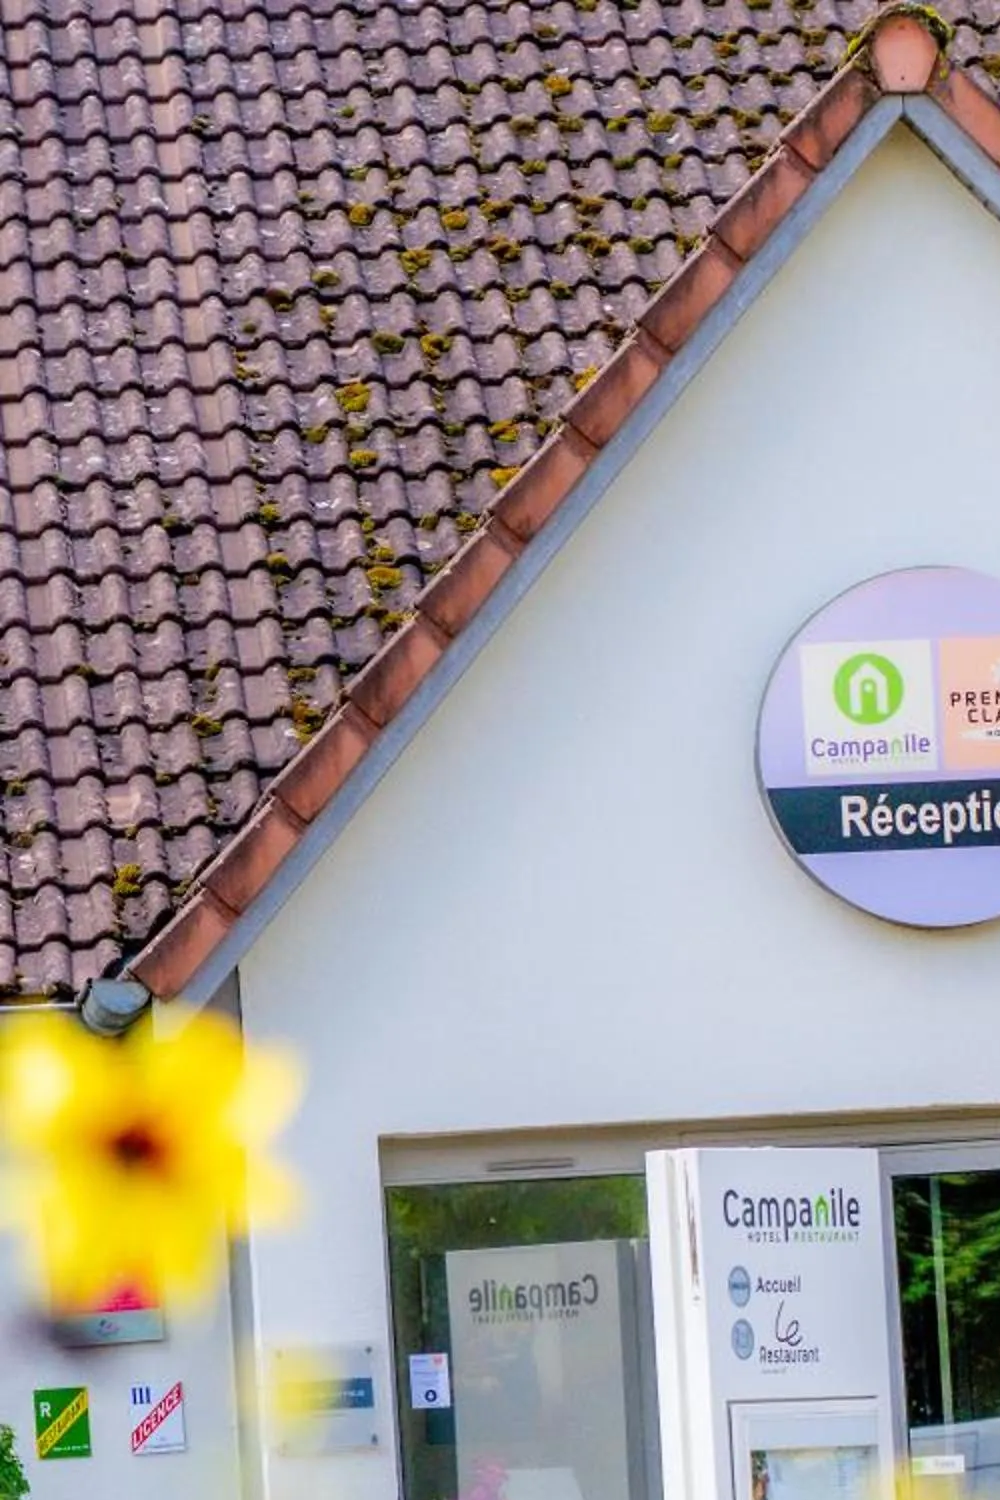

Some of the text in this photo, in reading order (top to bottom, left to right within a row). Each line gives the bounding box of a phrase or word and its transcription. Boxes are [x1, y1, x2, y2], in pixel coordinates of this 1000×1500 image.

[811, 733, 931, 763] Campanile
[723, 1188, 860, 1243] Campanile
[756, 1275, 801, 1293] Accueil
[758, 1345, 820, 1364] Restaurant
[39, 1401, 52, 1418] R
[132, 1384, 182, 1449] LICENCE
